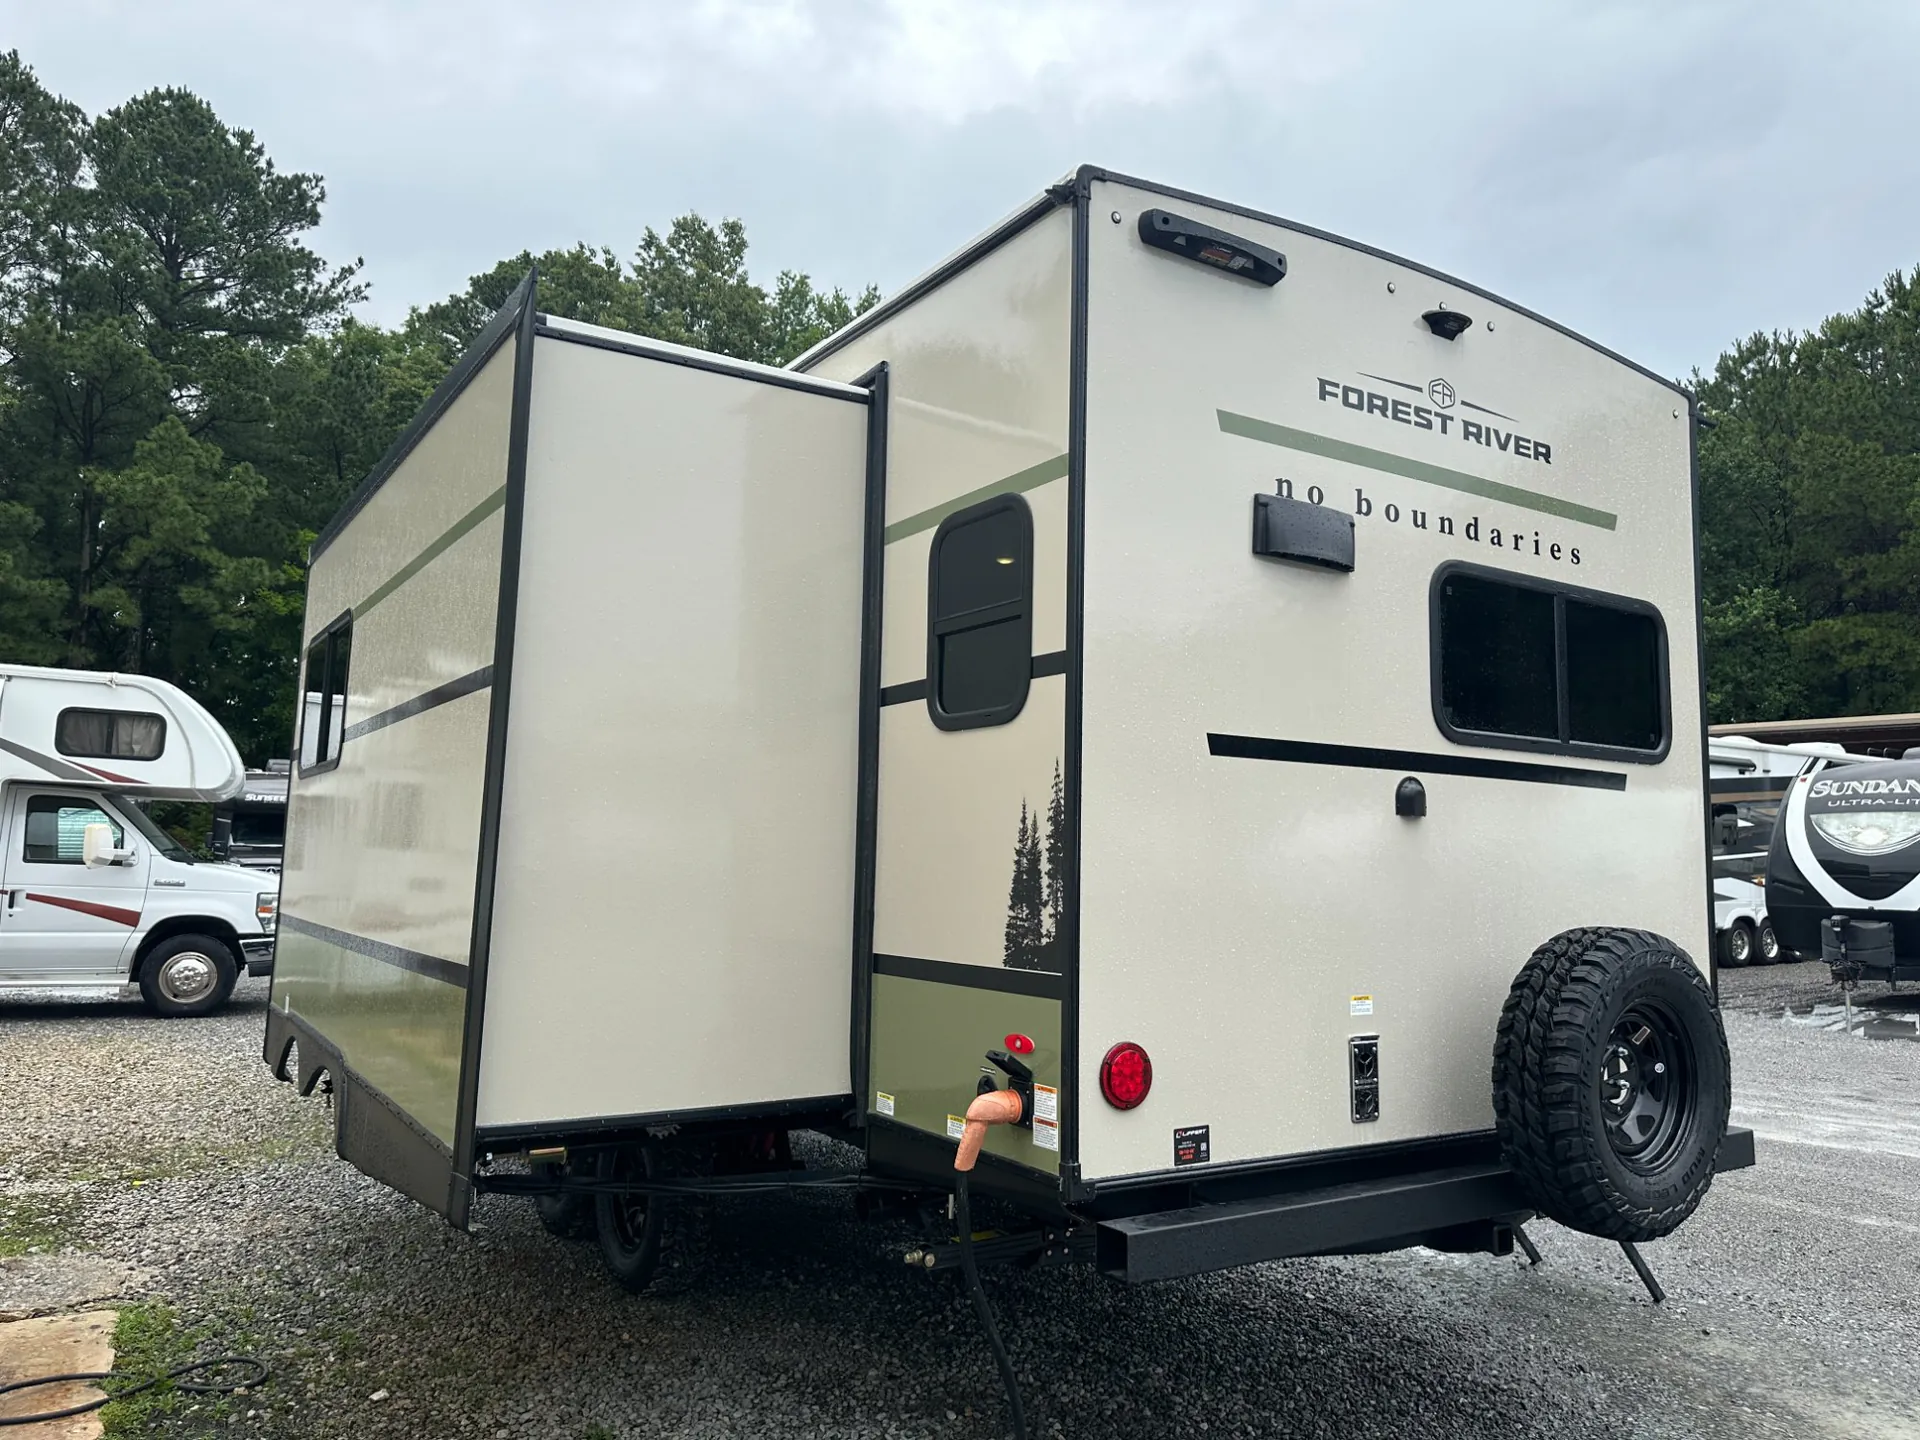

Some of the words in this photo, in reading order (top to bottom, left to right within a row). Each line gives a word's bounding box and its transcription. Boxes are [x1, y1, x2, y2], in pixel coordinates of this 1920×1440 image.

[1317, 377, 1454, 435] FOREST
[1461, 418, 1552, 464] RIVER
[1275, 476, 1324, 505] no
[1355, 488, 1581, 565] boundaries
